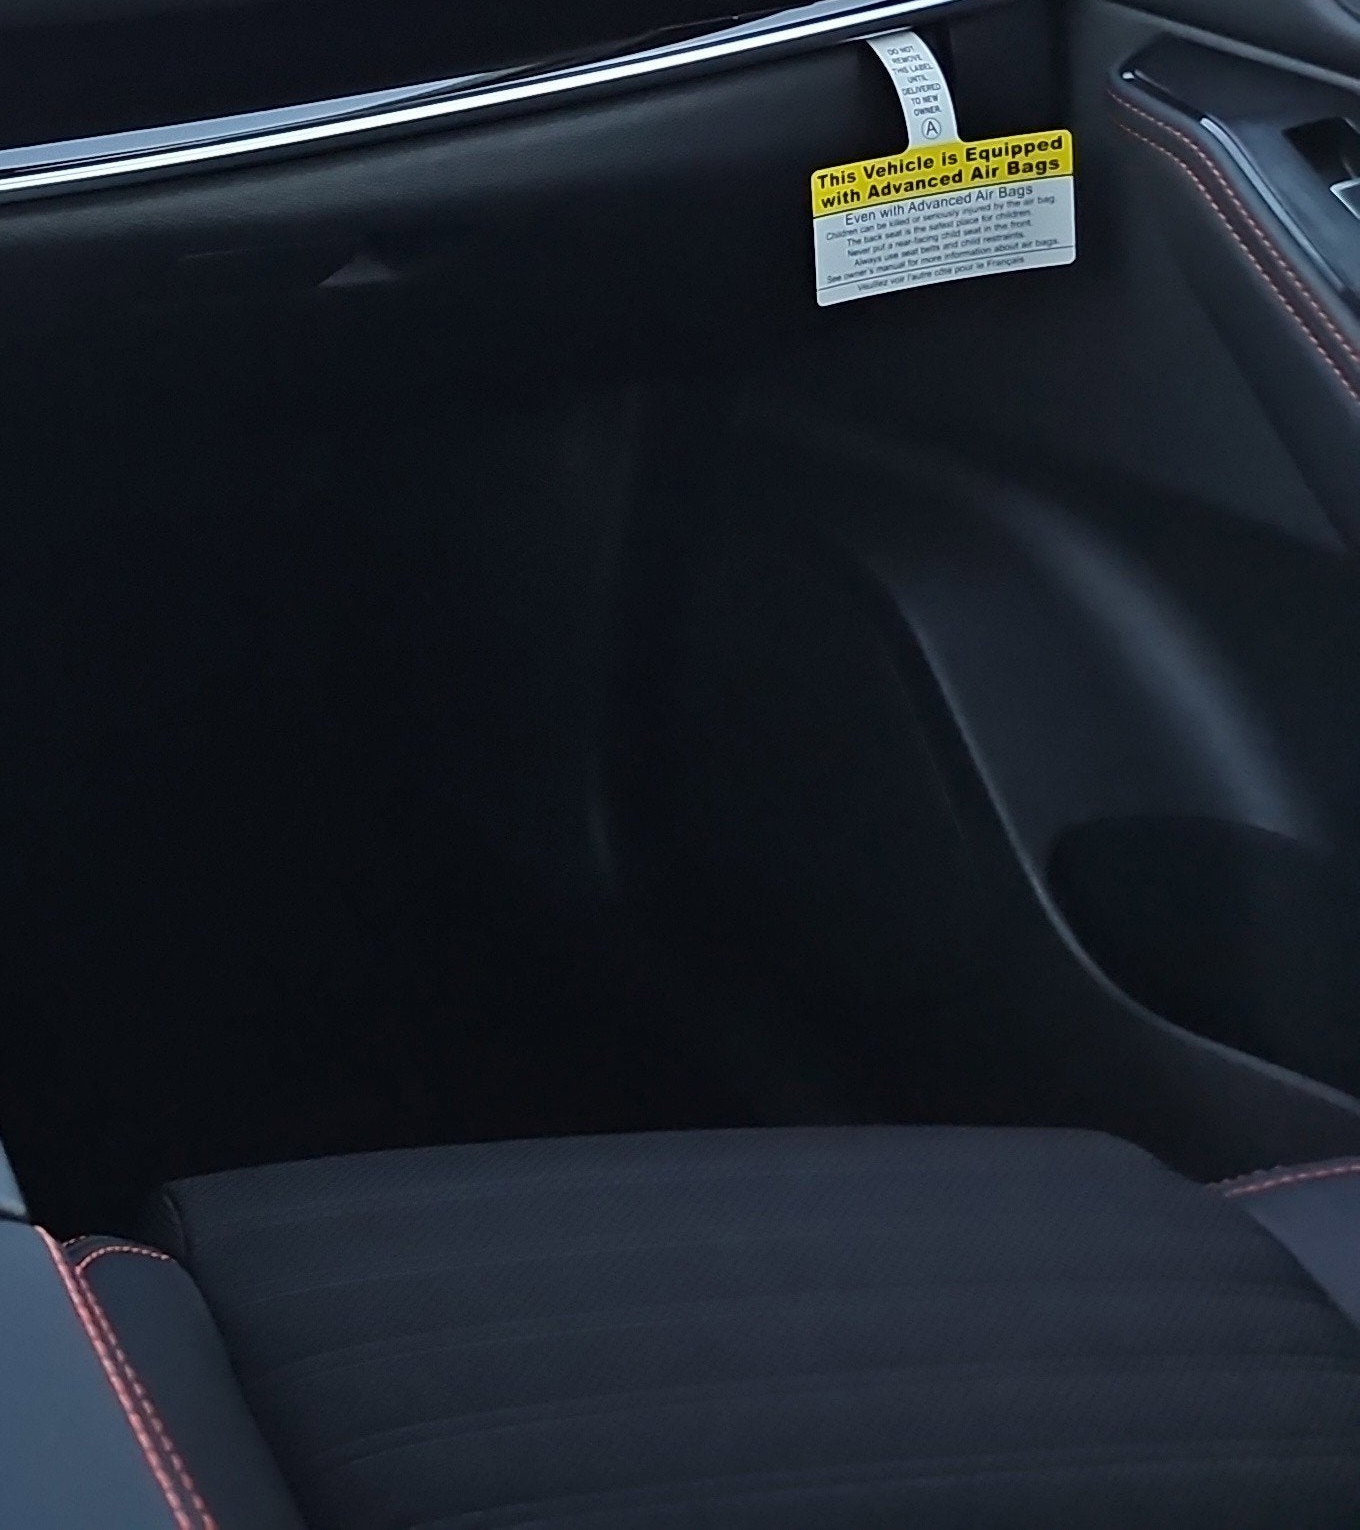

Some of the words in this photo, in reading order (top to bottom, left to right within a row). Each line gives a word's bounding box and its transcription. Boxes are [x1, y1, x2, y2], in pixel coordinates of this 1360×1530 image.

[901, 82, 941, 95] DELIVERED
[911, 97, 920, 105] TO
[922, 95, 939, 103] NEW
[817, 170, 856, 189] This
[863, 156, 934, 179] Vehicle
[941, 152, 958, 166] is
[965, 135, 1062, 162] Equipped
[821, 189, 861, 208] with
[867, 169, 963, 199] Advanced
[970, 165, 999, 181] Air
[1007, 159, 1060, 175] Bags
[845, 211, 876, 225] Even
[880, 204, 905, 219] with
[908, 193, 972, 213] Advanced
[975, 189, 994, 202] Air
[999, 185, 1033, 199] Bags
